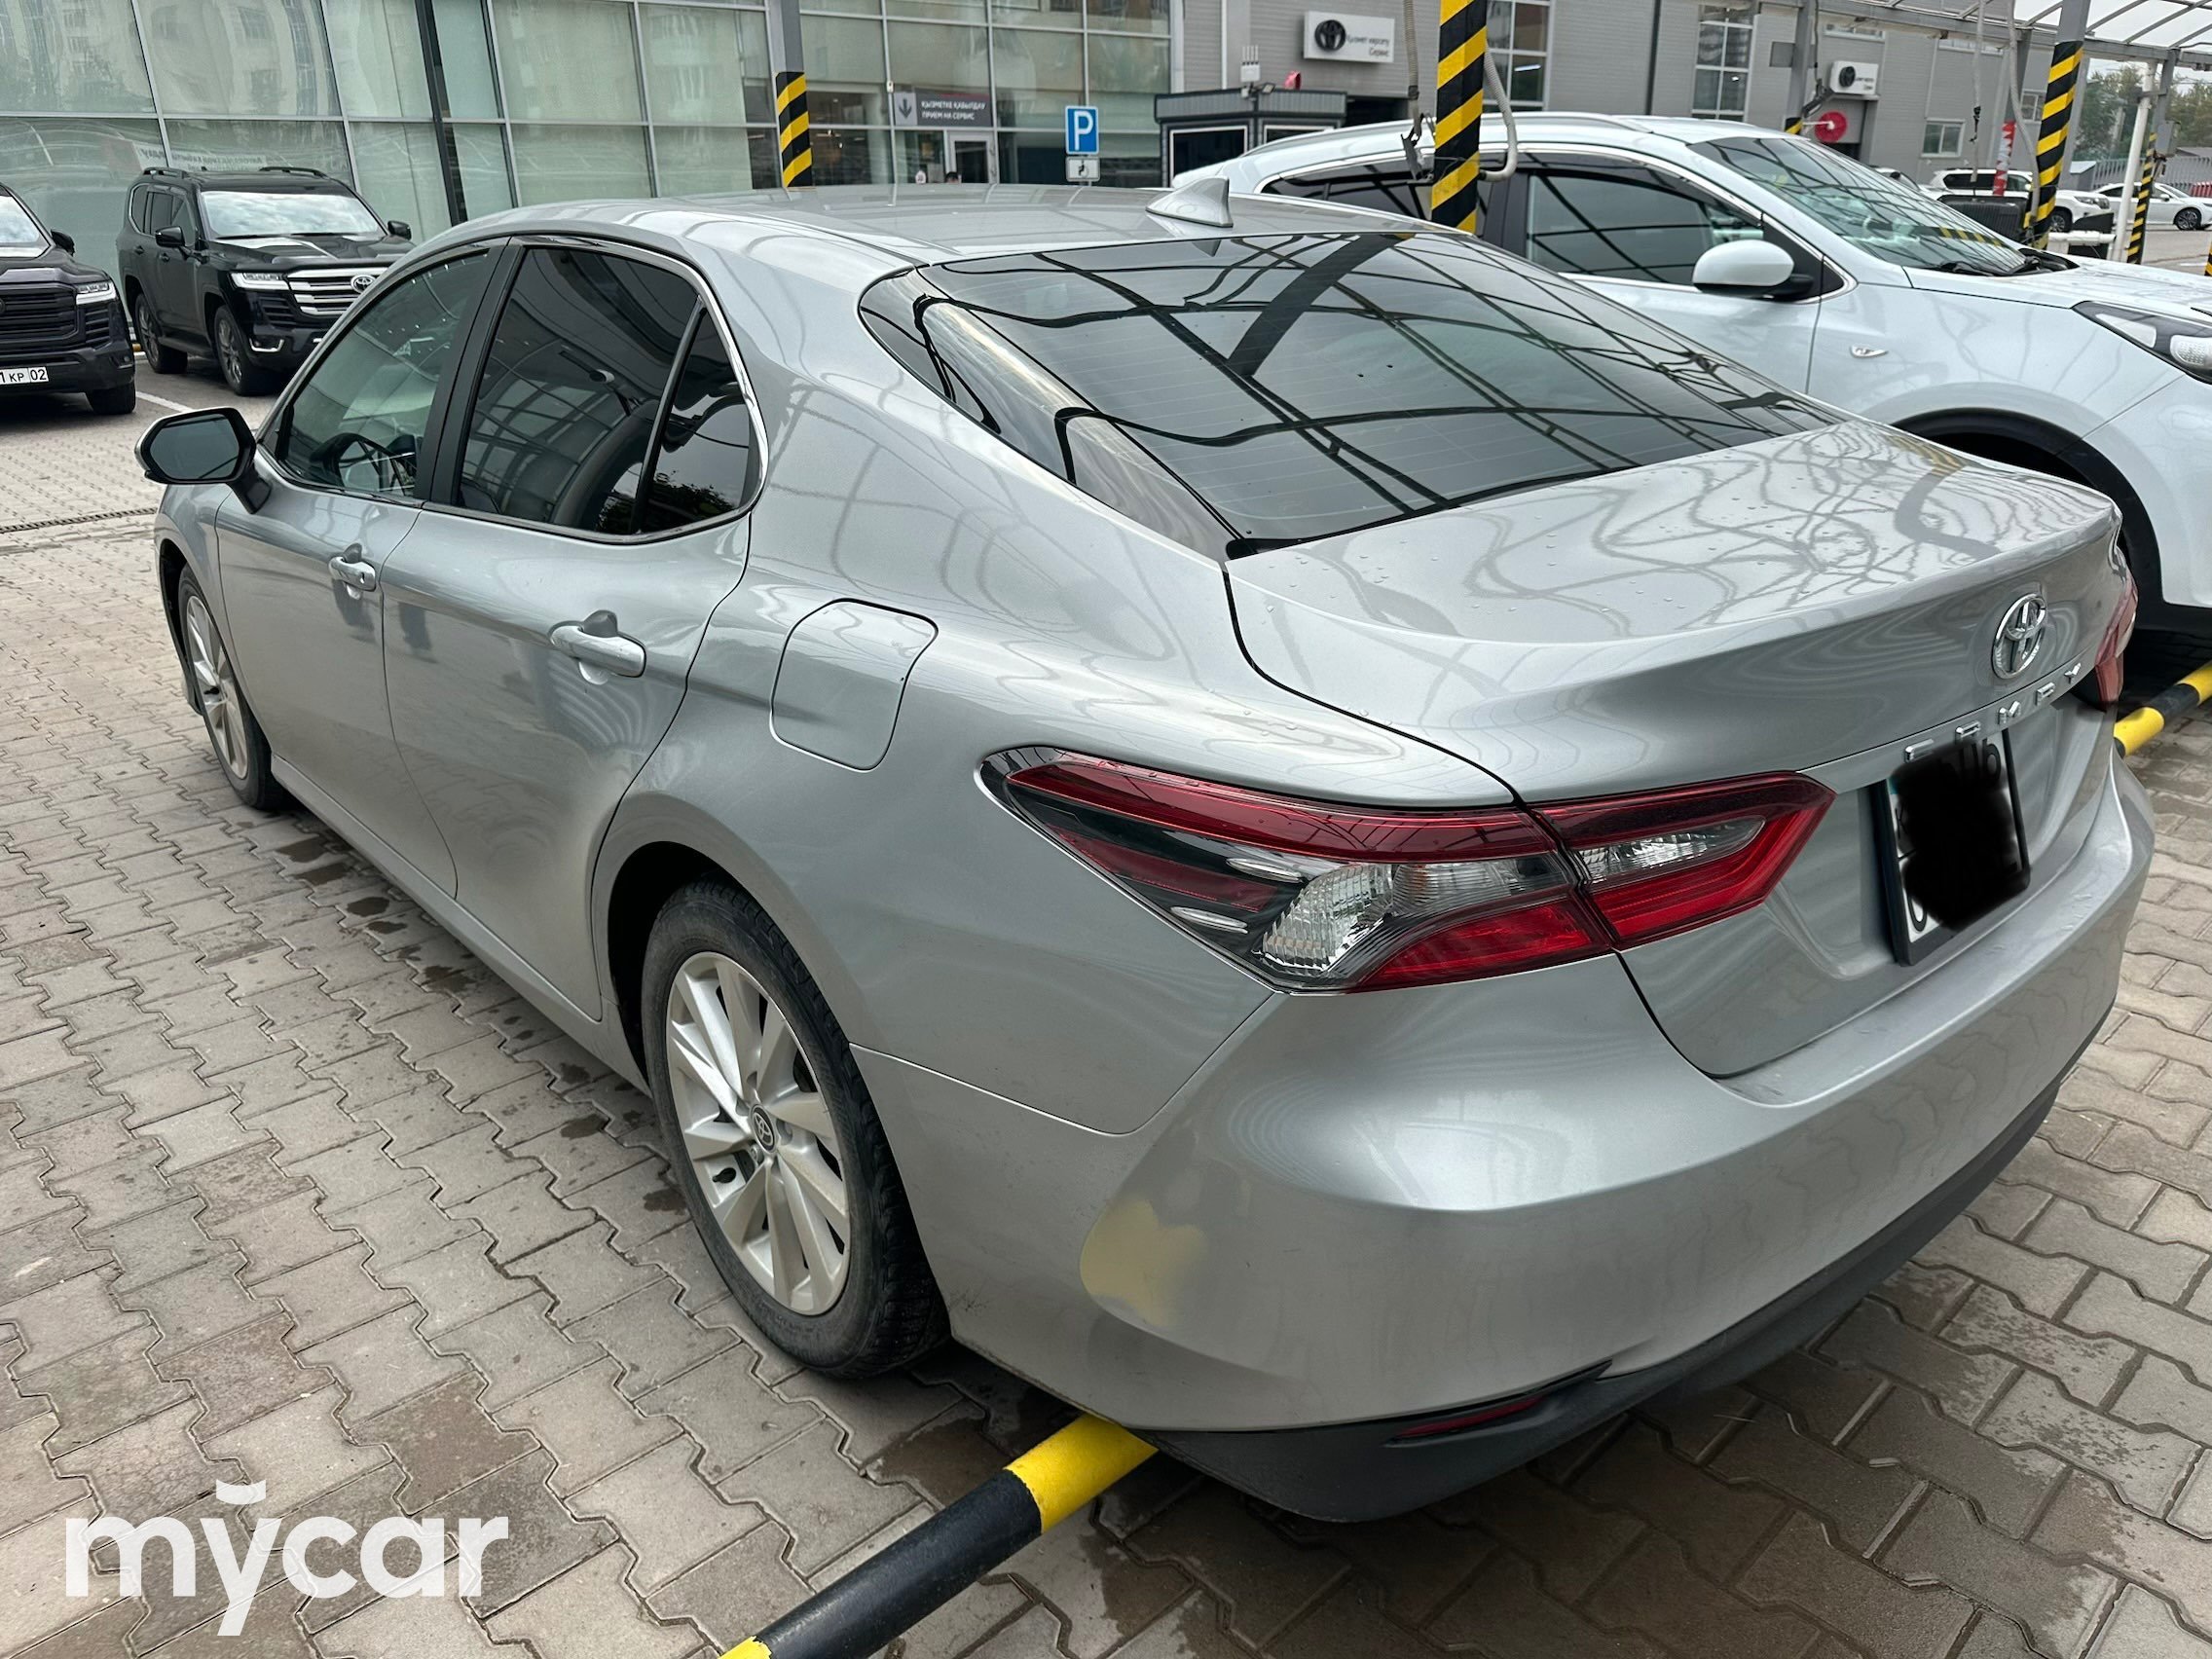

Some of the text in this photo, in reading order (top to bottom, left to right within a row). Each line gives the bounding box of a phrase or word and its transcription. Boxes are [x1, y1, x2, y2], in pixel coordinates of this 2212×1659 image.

[1074, 111, 1094, 151] P
[9, 372, 24, 383] KP
[29, 369, 47, 381] 02
